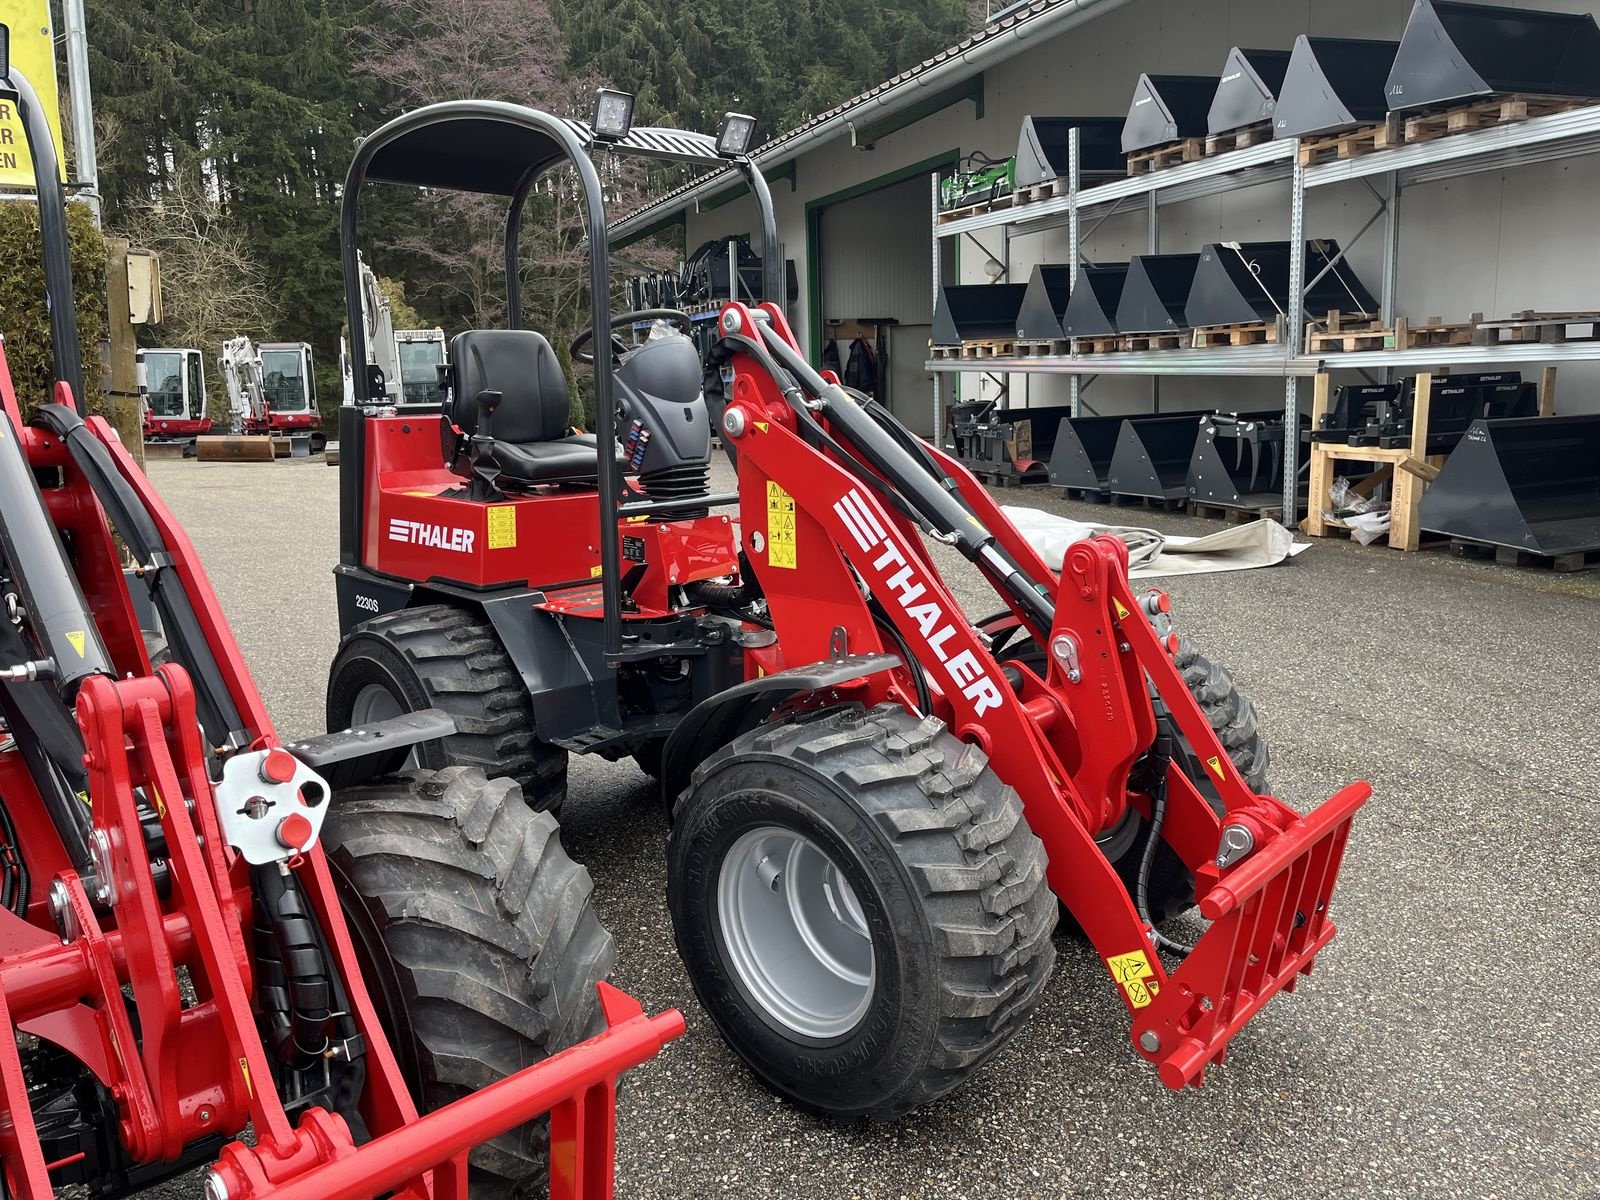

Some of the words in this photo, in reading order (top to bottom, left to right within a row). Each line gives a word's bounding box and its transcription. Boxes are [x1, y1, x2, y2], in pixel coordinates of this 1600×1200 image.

[0, 128, 14, 144] R
[409, 521, 475, 553] THALER
[355, 594, 379, 613] 2230S
[873, 537, 1004, 717] THALER
